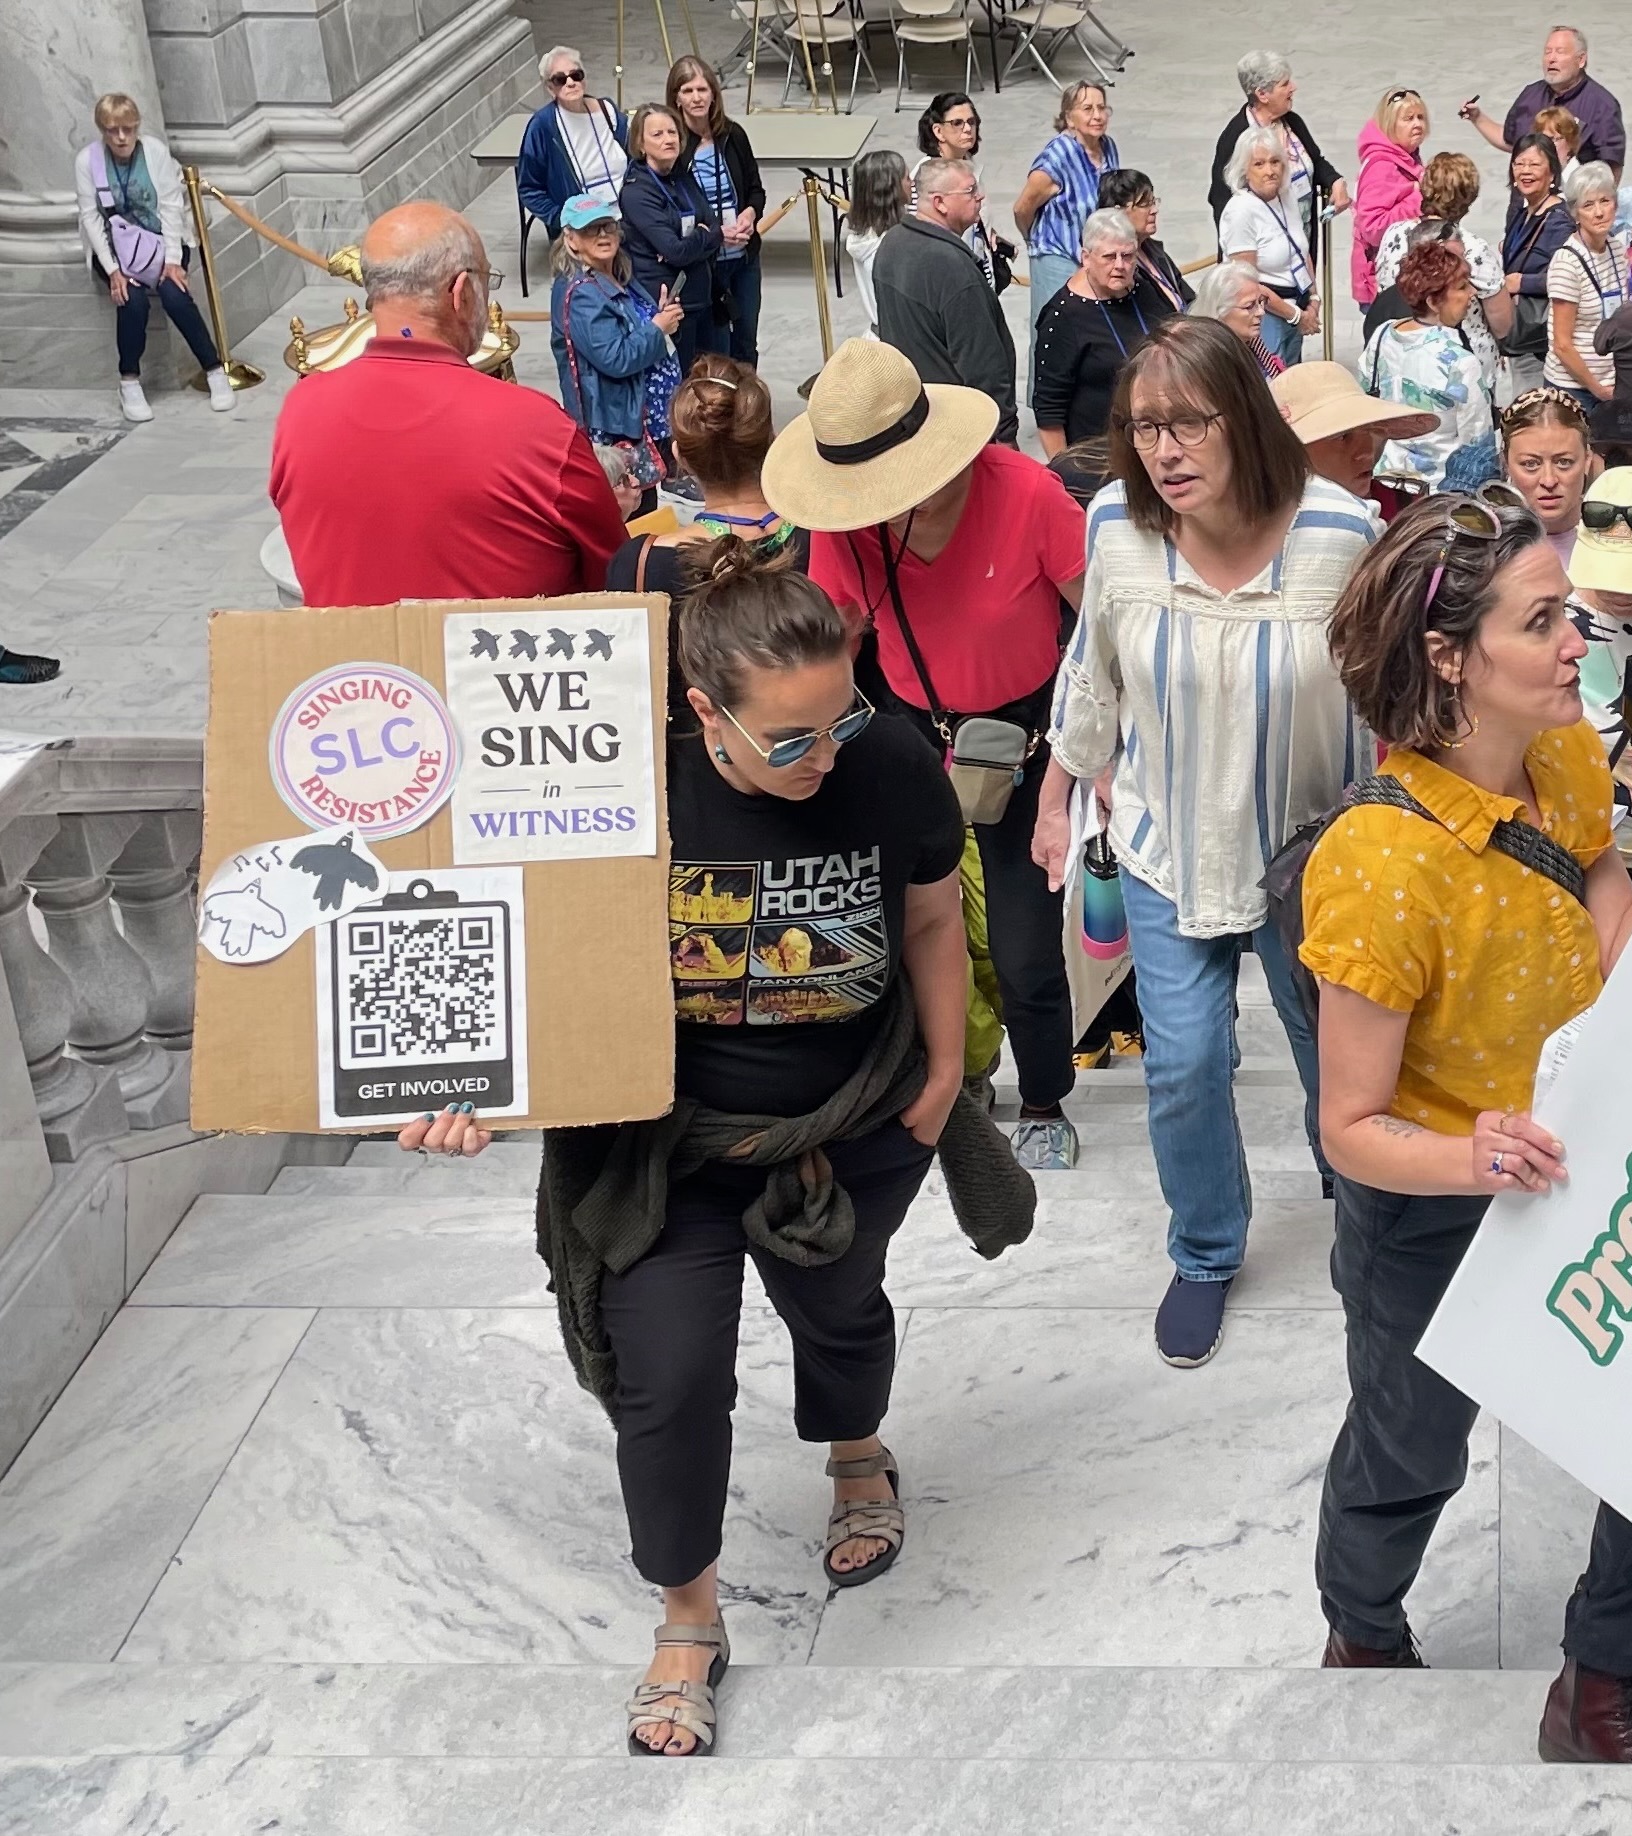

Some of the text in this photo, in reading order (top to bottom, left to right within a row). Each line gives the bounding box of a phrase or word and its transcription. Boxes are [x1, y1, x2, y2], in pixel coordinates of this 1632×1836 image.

[297, 679, 413, 730] SINGING
[493, 670, 591, 713] WE
[310, 716, 421, 776] SLC
[480, 722, 622, 768] SING
[299, 750, 442, 824] RESISTANCE
[541, 778, 562, 800] in
[468, 806, 637, 839] WITNESS
[762, 845, 881, 890] UTAH
[760, 874, 883, 918] ROCKS
[844, 905, 881, 922] ZION
[357, 1076, 491, 1100] GET INVOLVED
